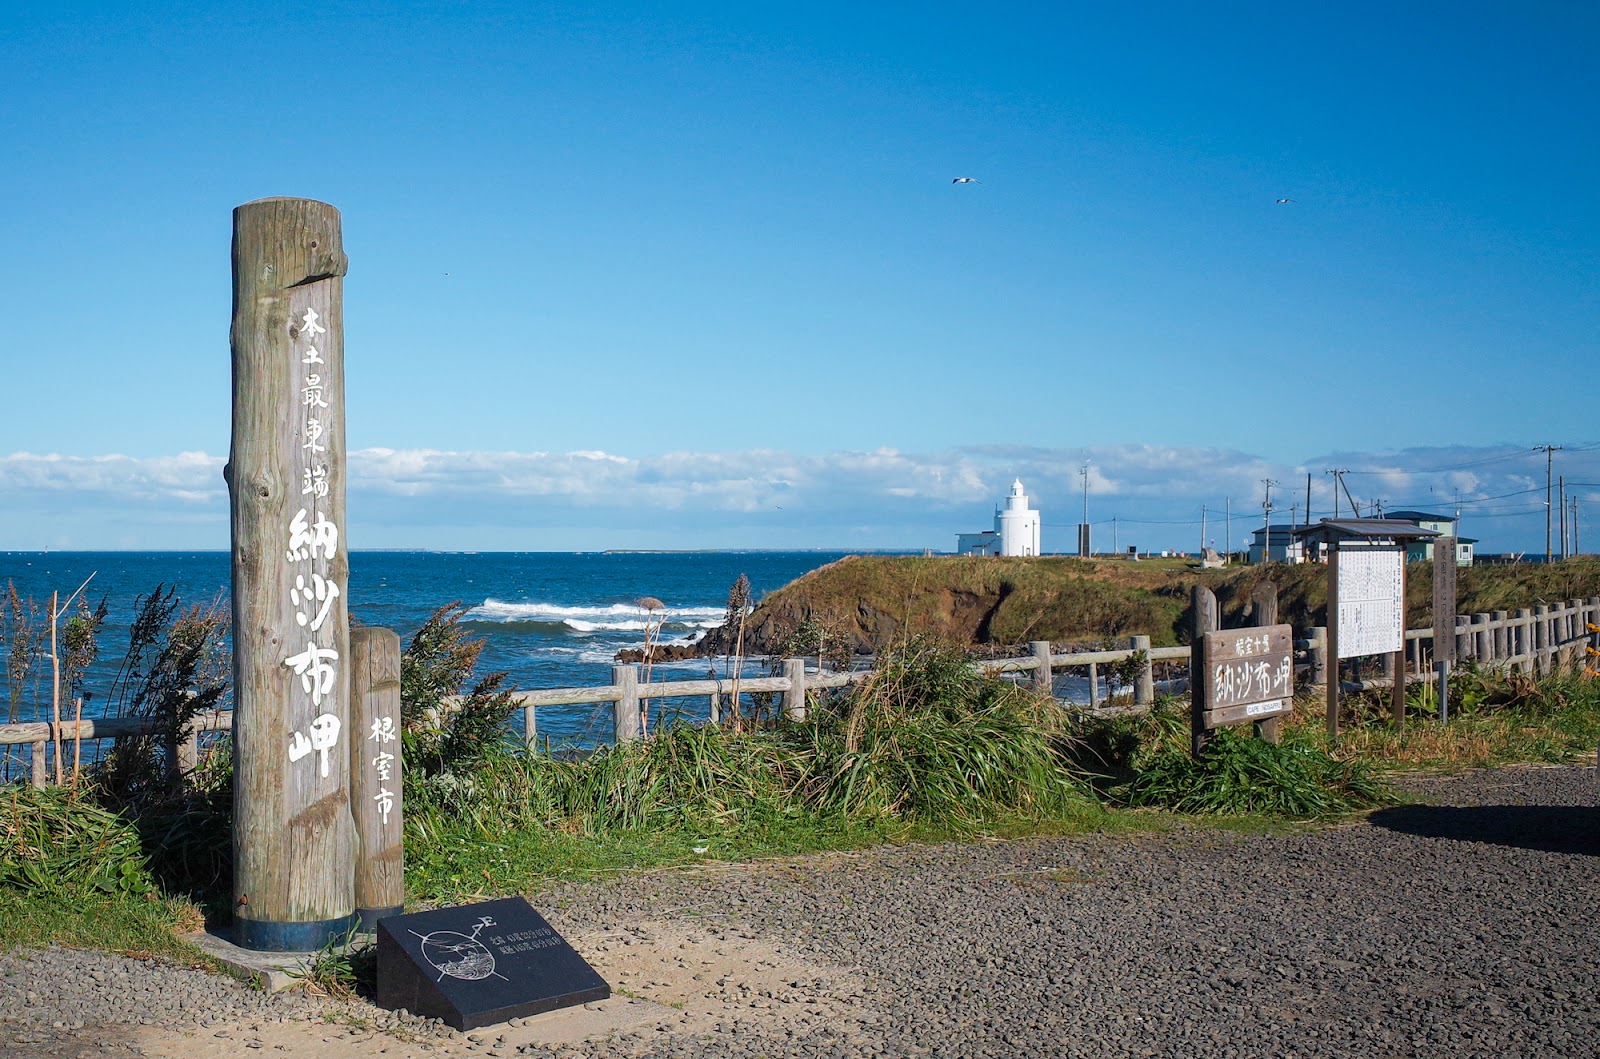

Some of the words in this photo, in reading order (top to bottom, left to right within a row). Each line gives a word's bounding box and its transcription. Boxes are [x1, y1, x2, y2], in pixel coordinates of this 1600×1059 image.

[299, 307, 329, 499] 本土最東端
[285, 507, 341, 778] 納沙布岬
[1215, 655, 1291, 702] 納沙布岬
[1247, 705, 1260, 714] CAPE
[1261, 702, 1281, 712] NOSAPPU
[368, 717, 396, 825] 根室市
